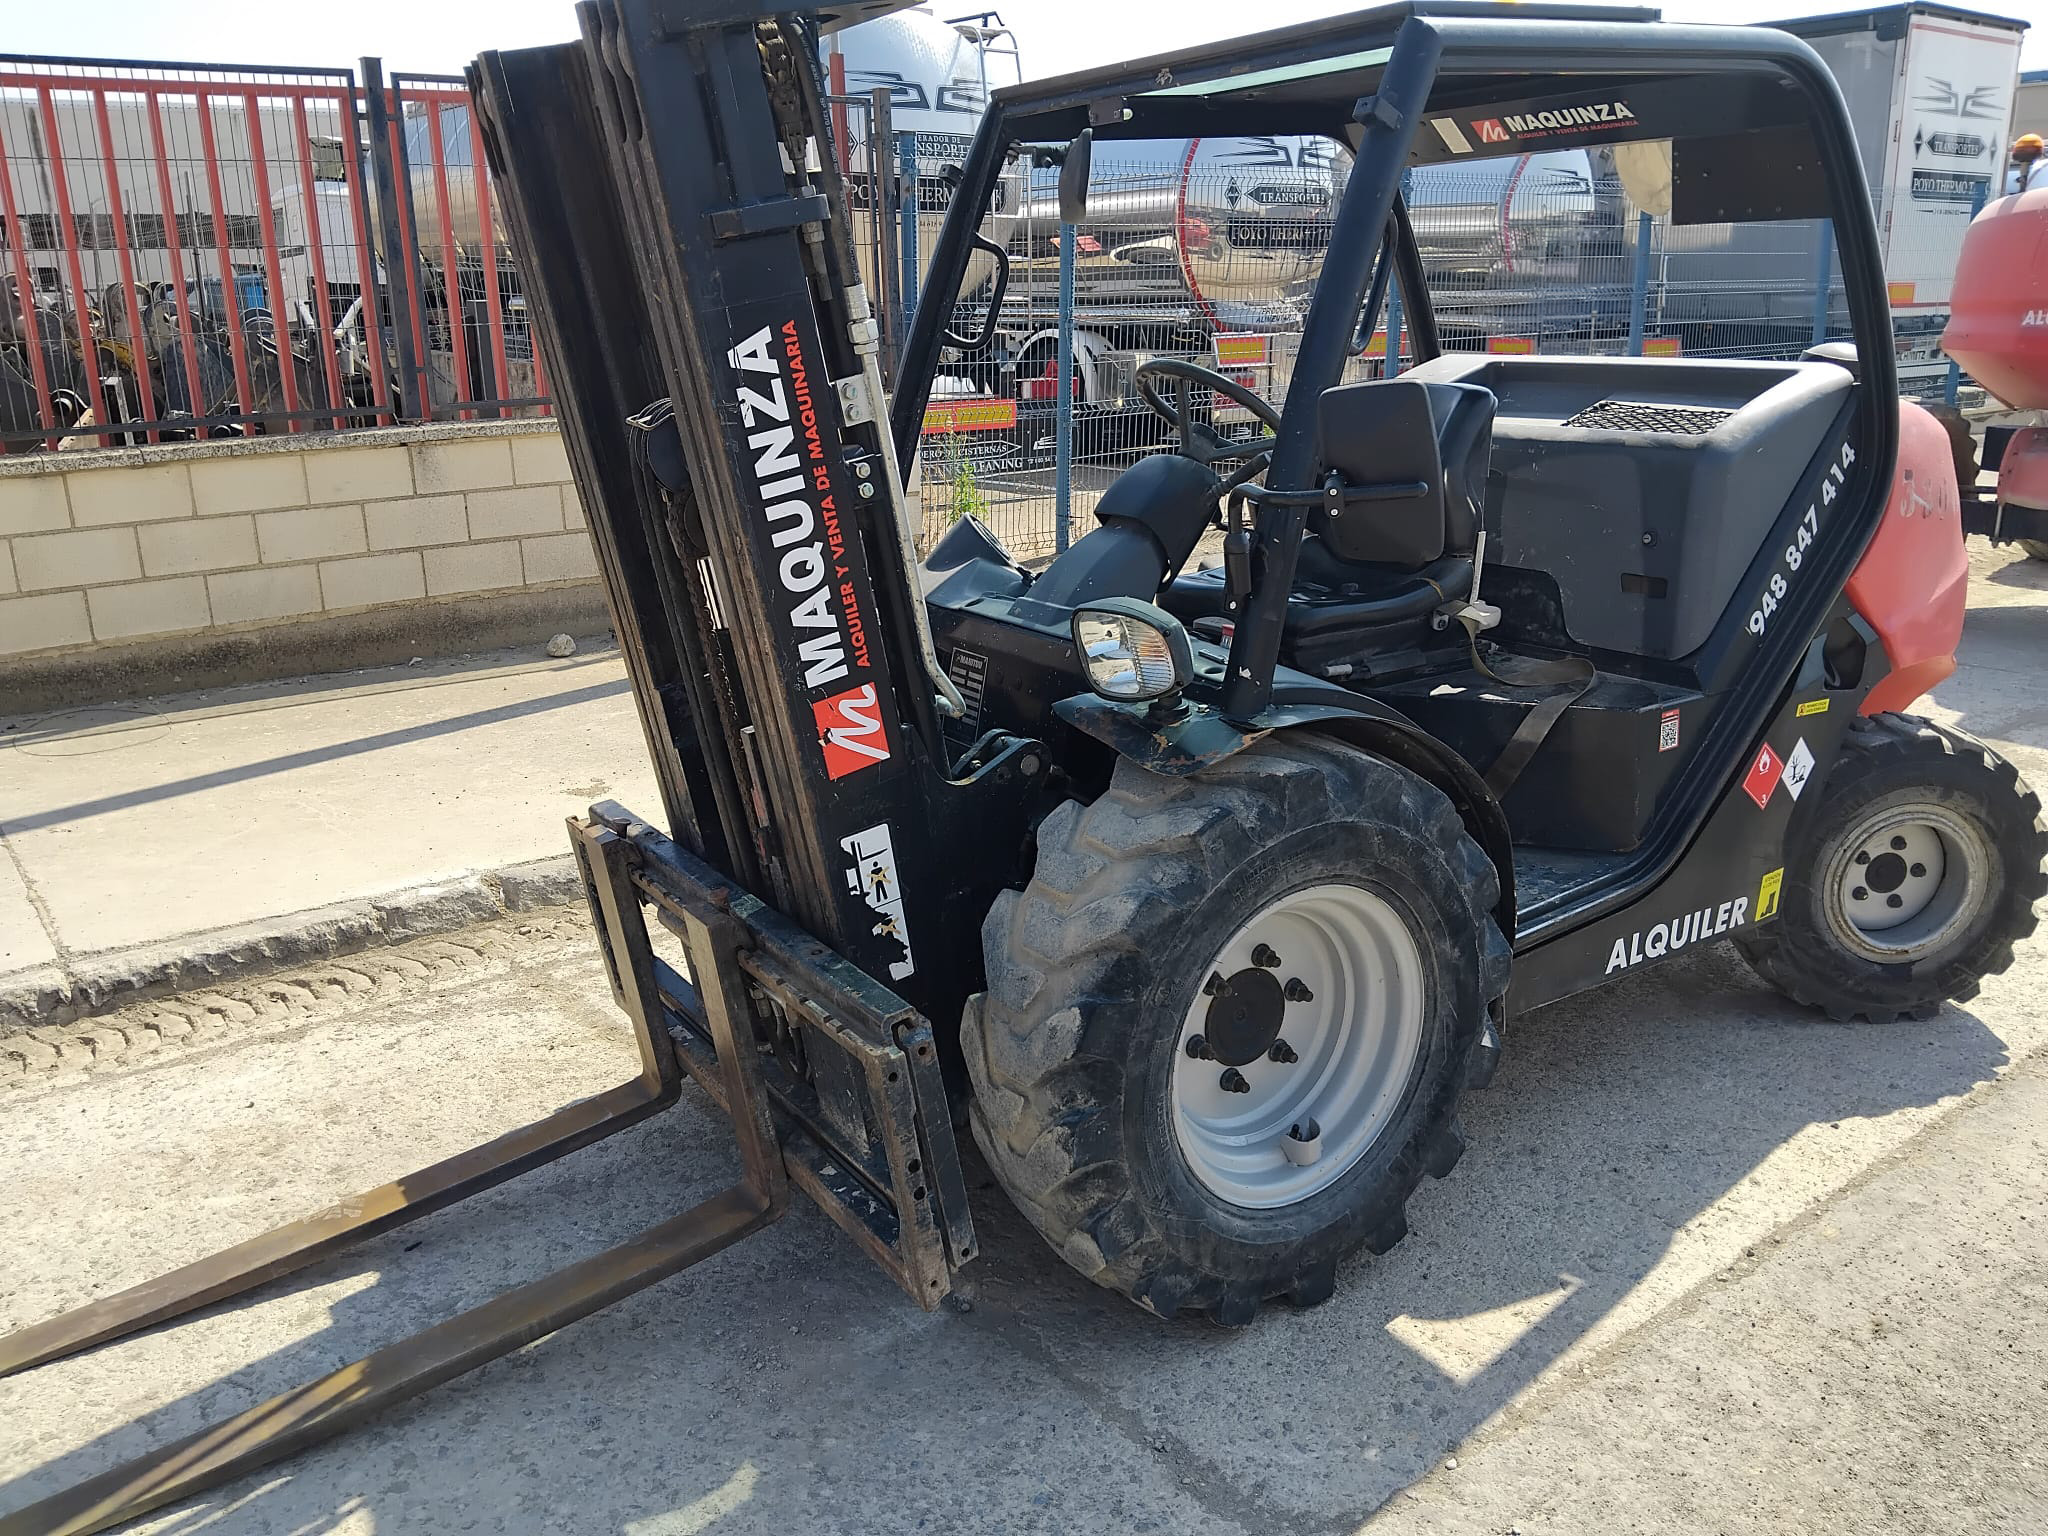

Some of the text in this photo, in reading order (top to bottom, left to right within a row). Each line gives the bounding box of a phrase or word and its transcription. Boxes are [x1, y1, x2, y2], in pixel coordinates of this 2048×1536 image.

[1503, 102, 1635, 132] MAQUINZA
[1516, 130, 1548, 139] ALQUILER
[1556, 126, 1579, 135] VENTA
[1579, 124, 1590, 132] DE
[1590, 119, 1639, 131] MAQUINARIA
[918, 135, 950, 143] ERADOR
[1934, 141, 1979, 155] TRANSPORTES
[1912, 178, 1935, 192] POYO
[959, 444, 1007, 457] CISTERNAS
[970, 459, 1023, 474] LEANING
[781, 319, 871, 668] ALQUILER Y VENTA DE MAQUINARIA
[727, 325, 849, 689] MAQUINZA
[1749, 441, 1856, 637] 948 847 414
[960, 655, 983, 668] MANITOU
[1760, 793, 1767, 804] 3
[1605, 896, 1749, 975] ALQUILER
